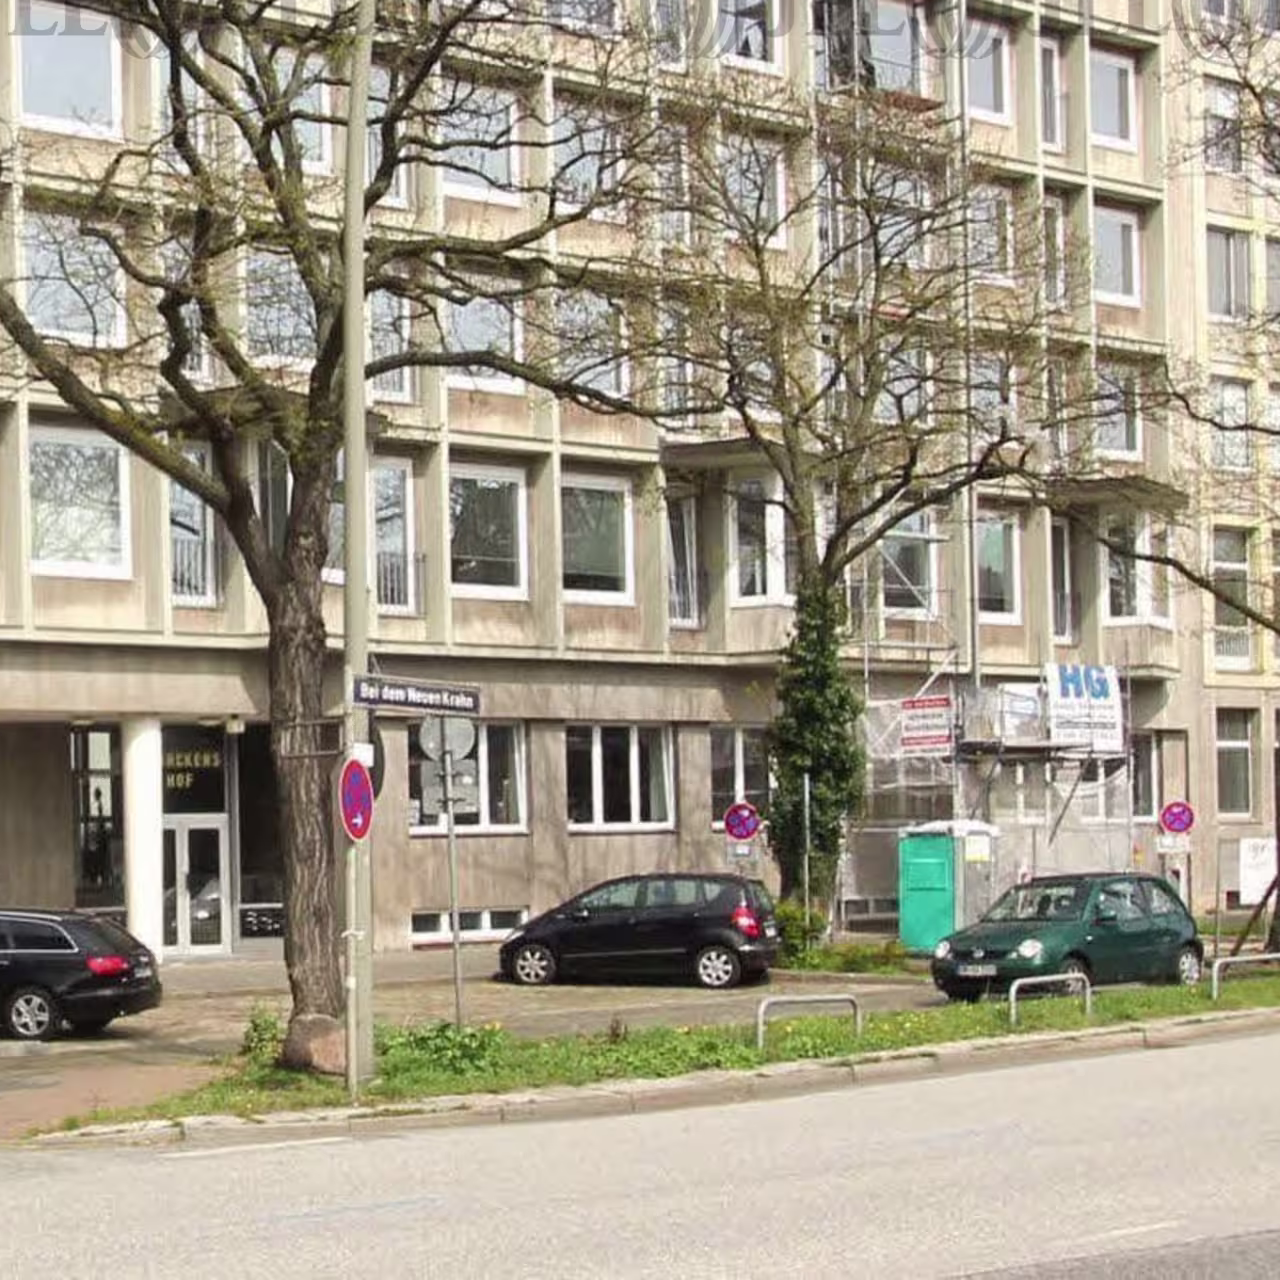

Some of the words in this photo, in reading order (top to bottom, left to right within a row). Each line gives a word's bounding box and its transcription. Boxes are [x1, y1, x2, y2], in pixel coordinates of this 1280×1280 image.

[360, 681, 379, 699] Bei
[382, 685, 406, 701] dem
[442, 689, 474, 708] Krahn
[1058, 665, 1110, 700] HG
